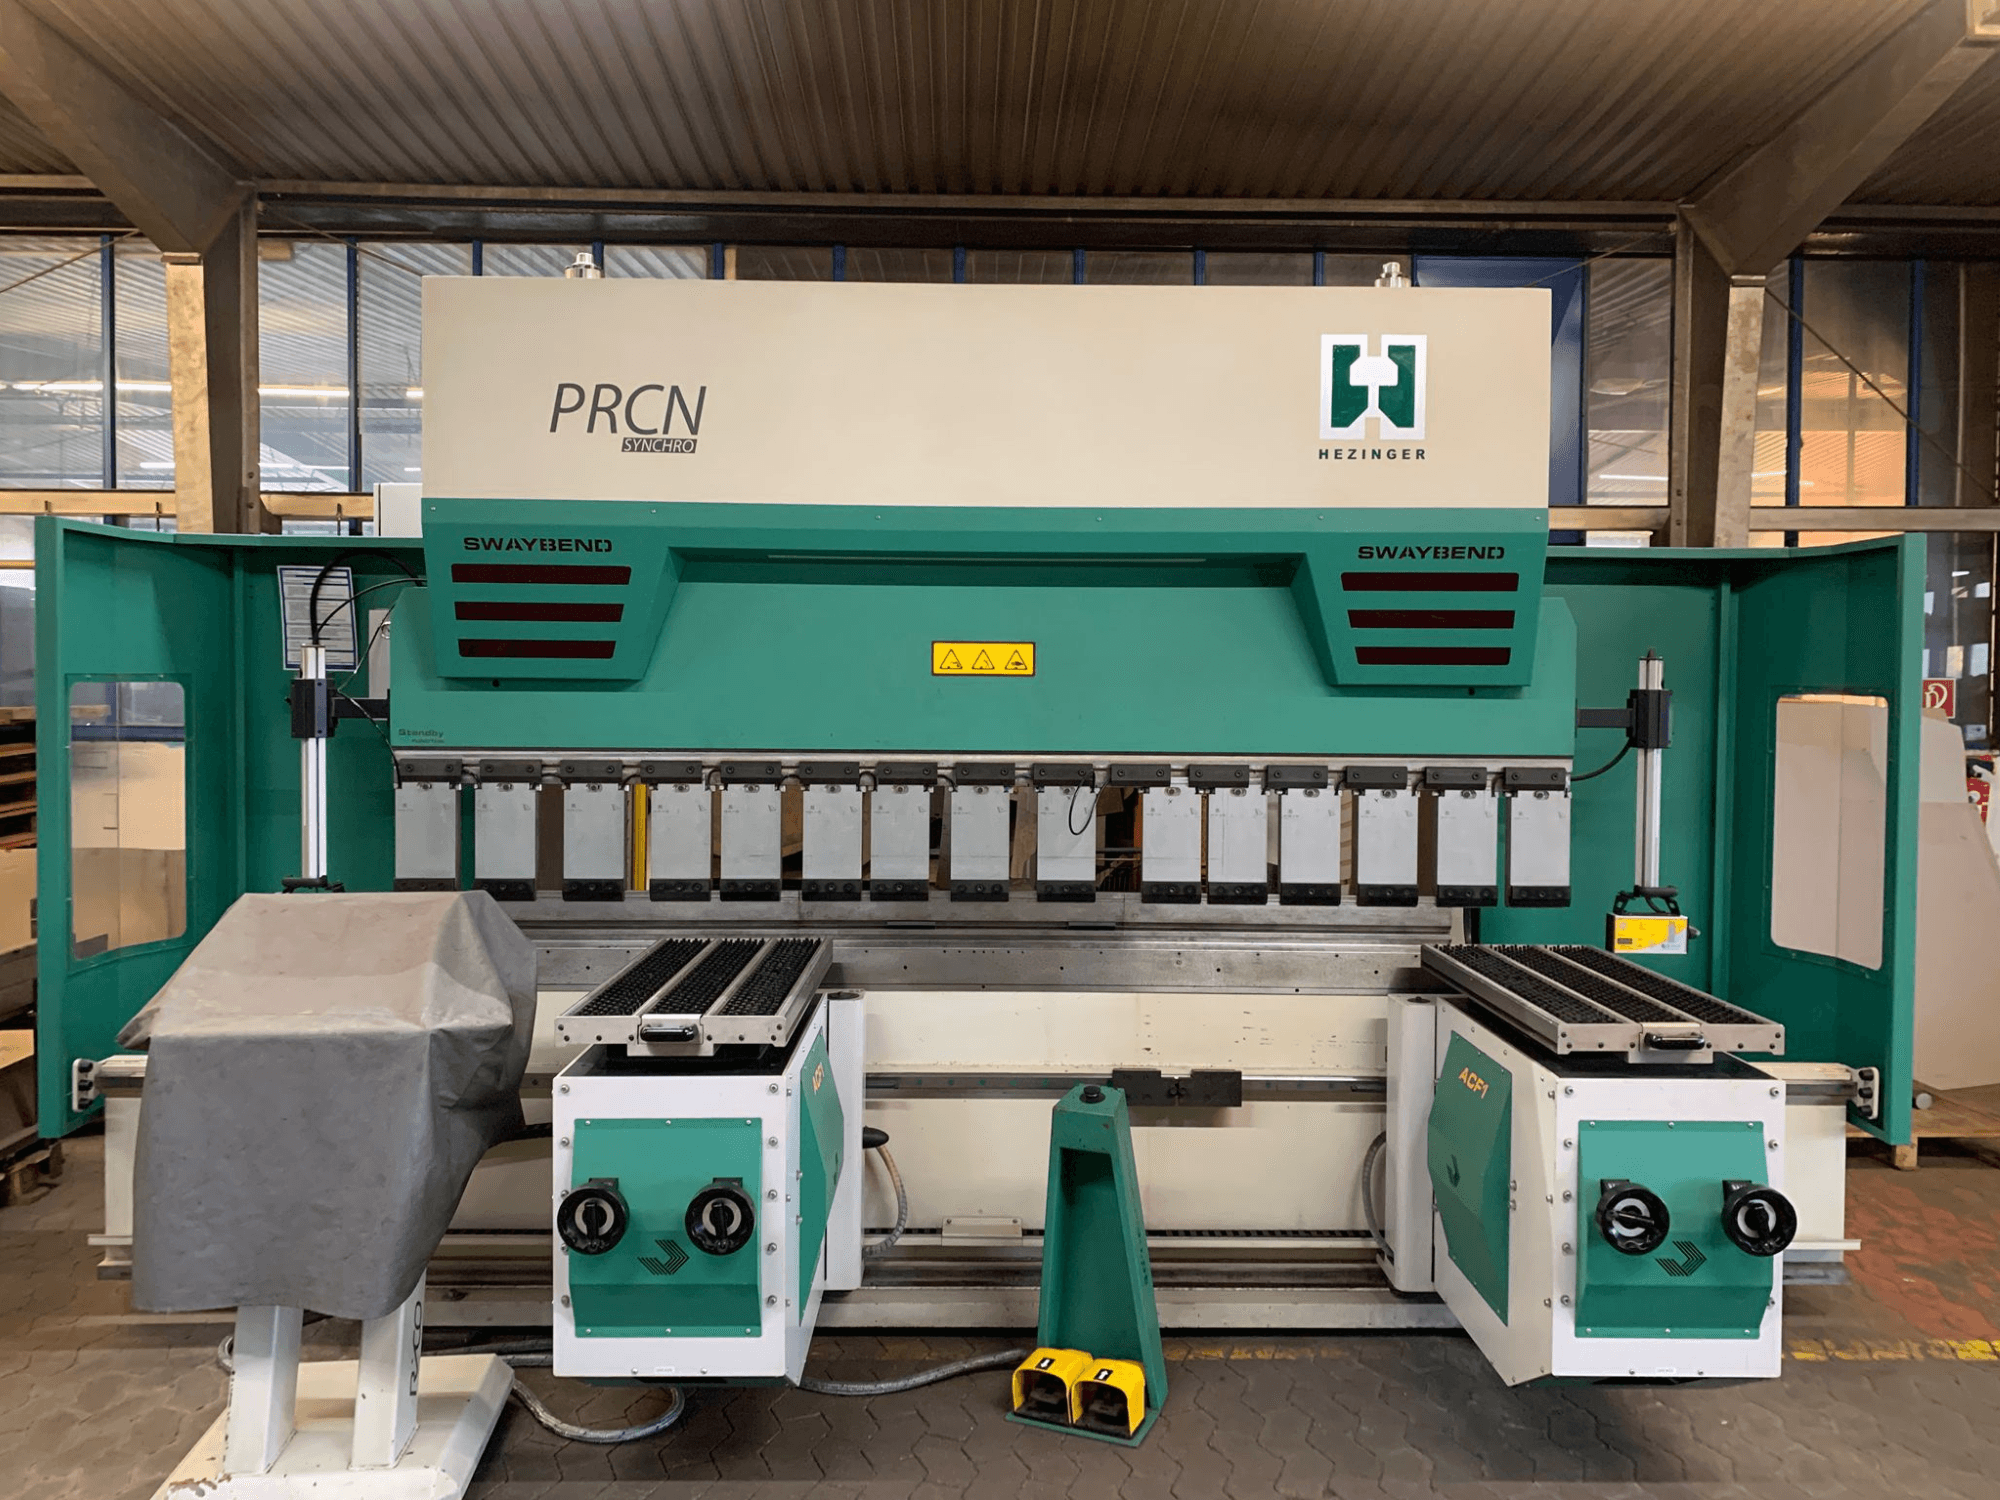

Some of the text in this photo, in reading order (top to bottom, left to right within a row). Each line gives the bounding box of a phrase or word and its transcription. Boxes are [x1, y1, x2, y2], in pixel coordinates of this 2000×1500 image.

[549, 382, 707, 436] PRCN
[623, 438, 695, 453] SYNCHRO
[1318, 448, 1426, 460] HEZINGER
[463, 537, 613, 553] SWAYBEND
[1358, 546, 1505, 560] SWAYBEND
[1458, 1066, 1490, 1100] ACF1
